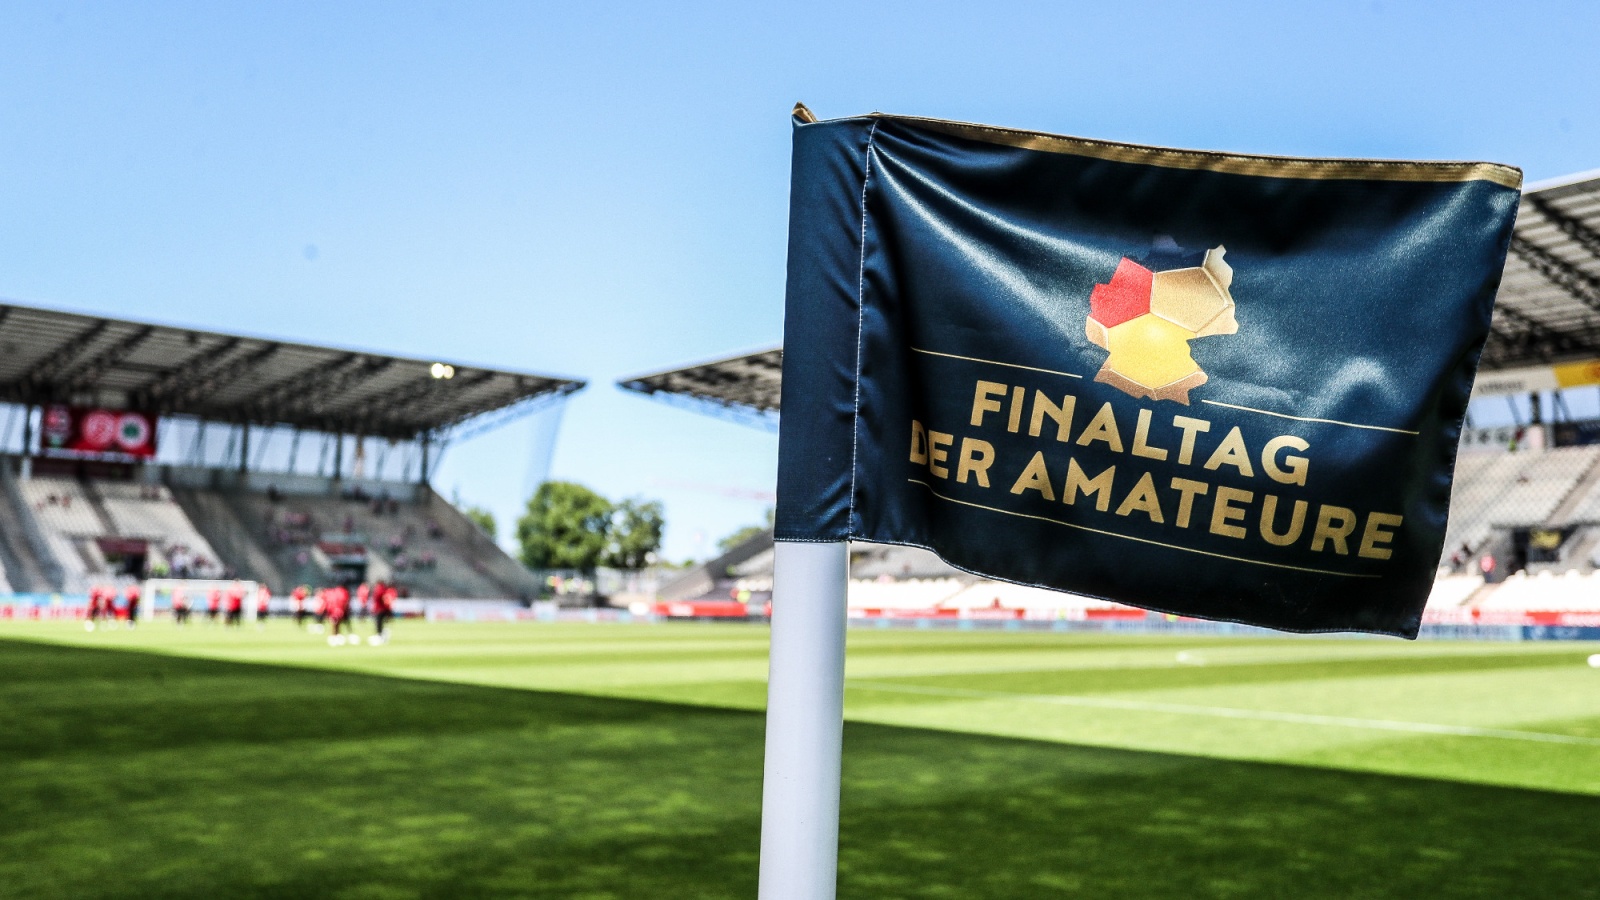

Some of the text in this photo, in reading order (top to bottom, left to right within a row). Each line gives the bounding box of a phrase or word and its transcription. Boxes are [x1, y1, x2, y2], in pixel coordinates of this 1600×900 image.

[909, 420, 1403, 559] DER AMATEURE
[970, 380, 1310, 486] FINALTAG
